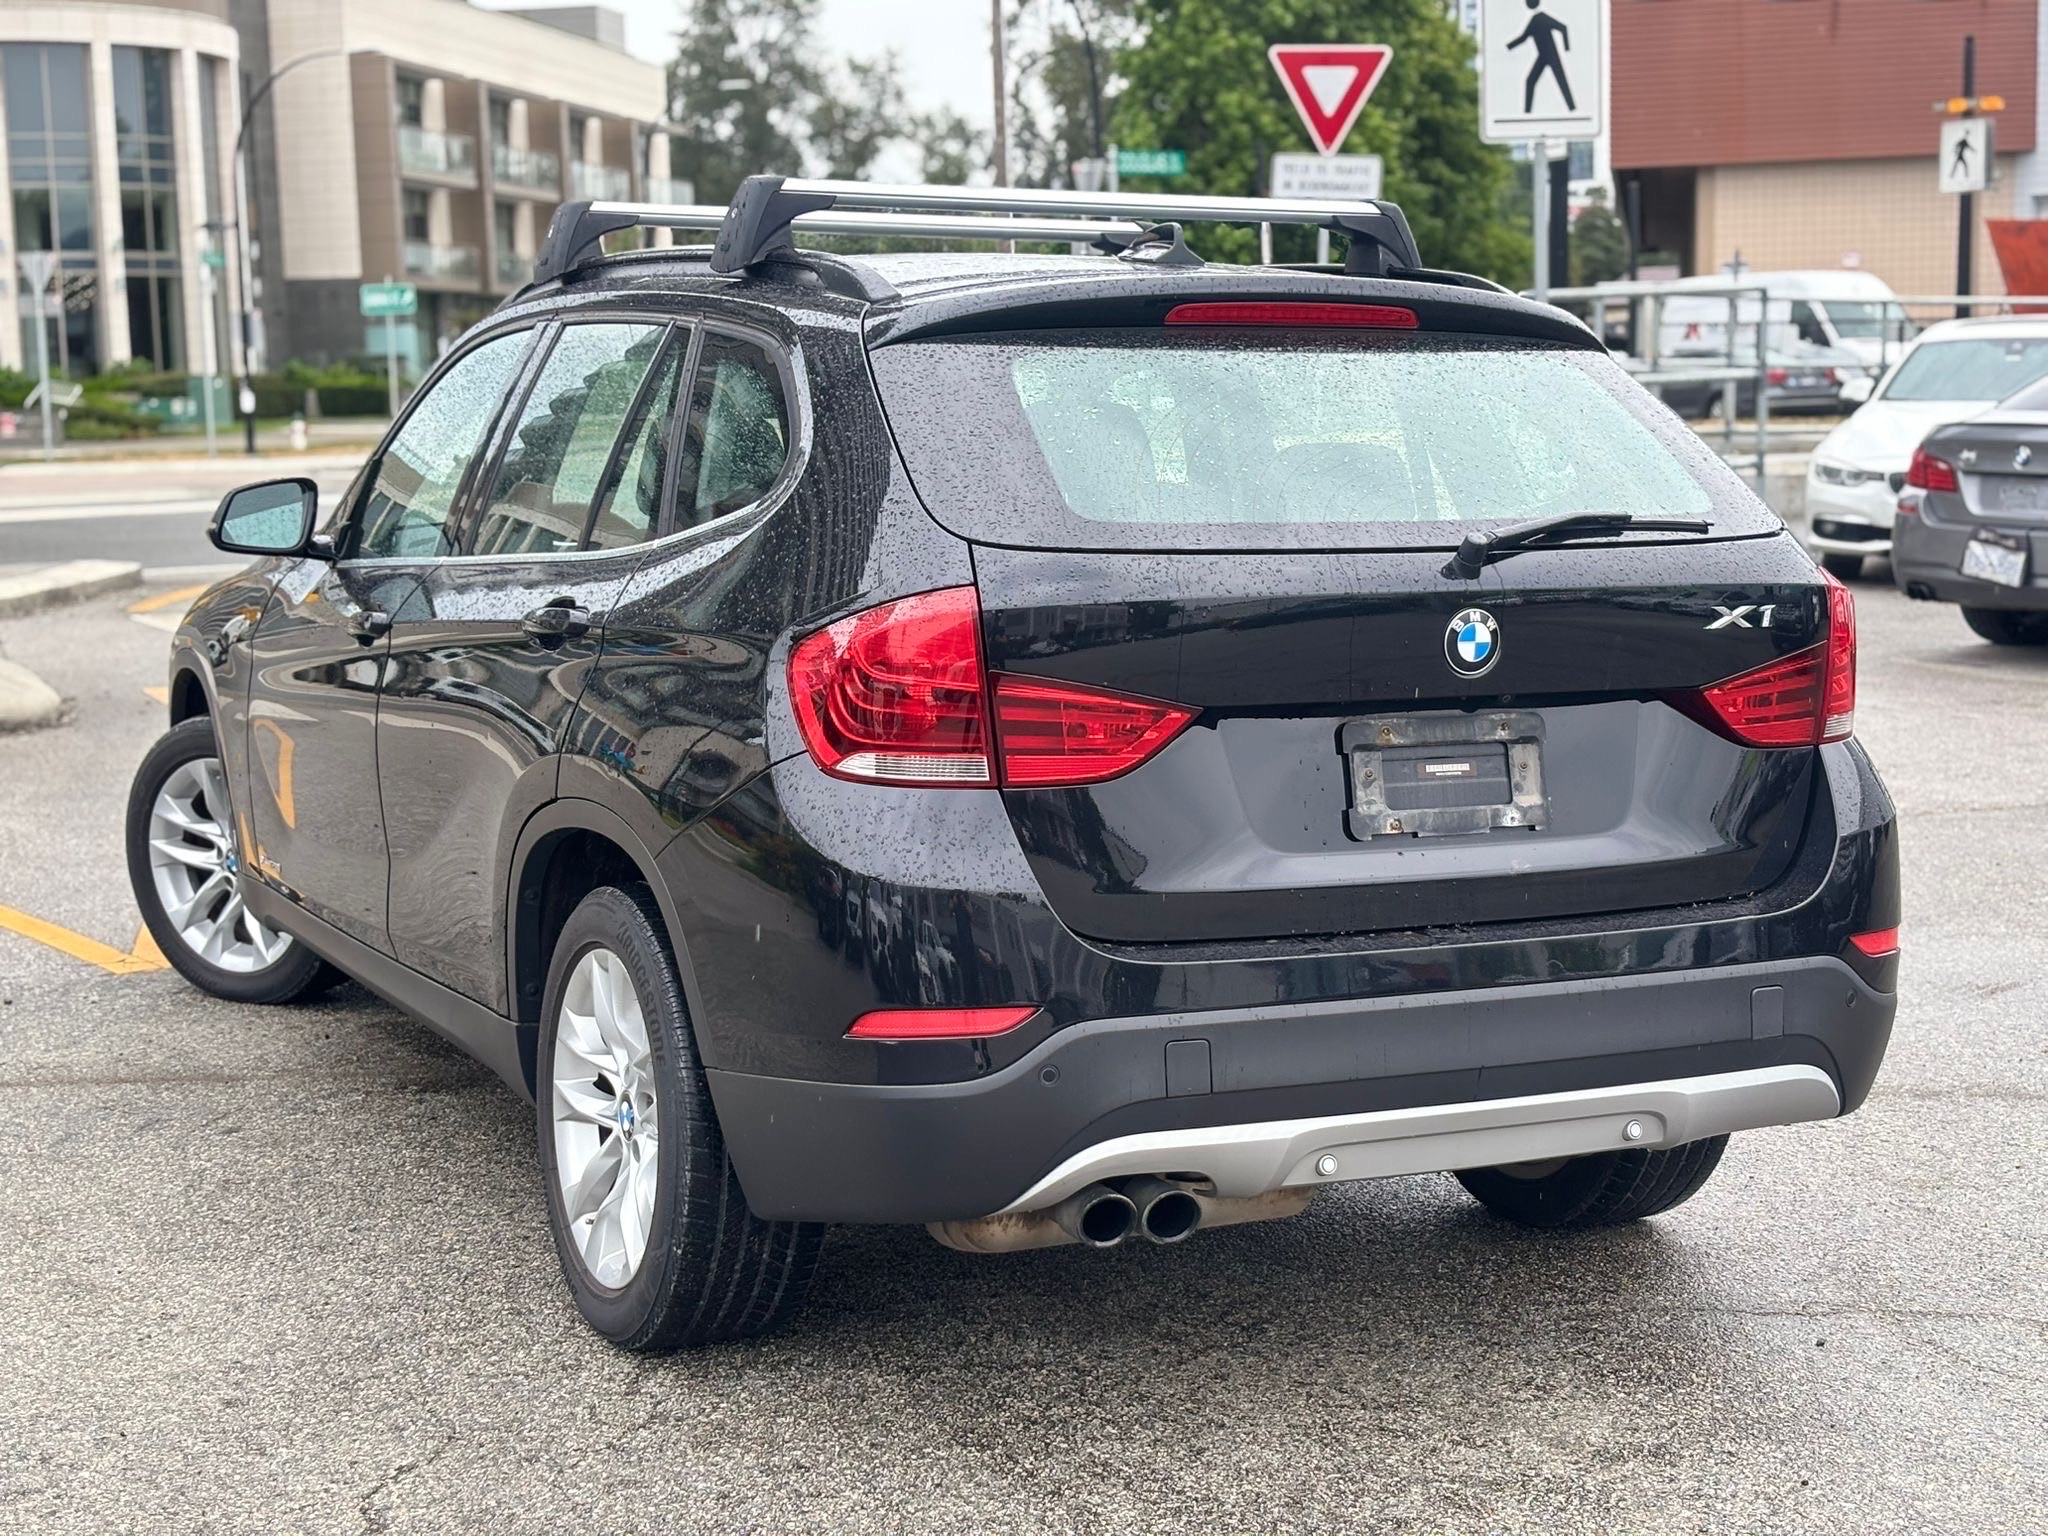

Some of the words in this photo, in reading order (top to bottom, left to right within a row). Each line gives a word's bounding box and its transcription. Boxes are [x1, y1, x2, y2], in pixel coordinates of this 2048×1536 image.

[1451, 610, 1497, 633] BMW
[1702, 604, 1777, 630] X1
[615, 919, 666, 1068] BRIDGESTONE
